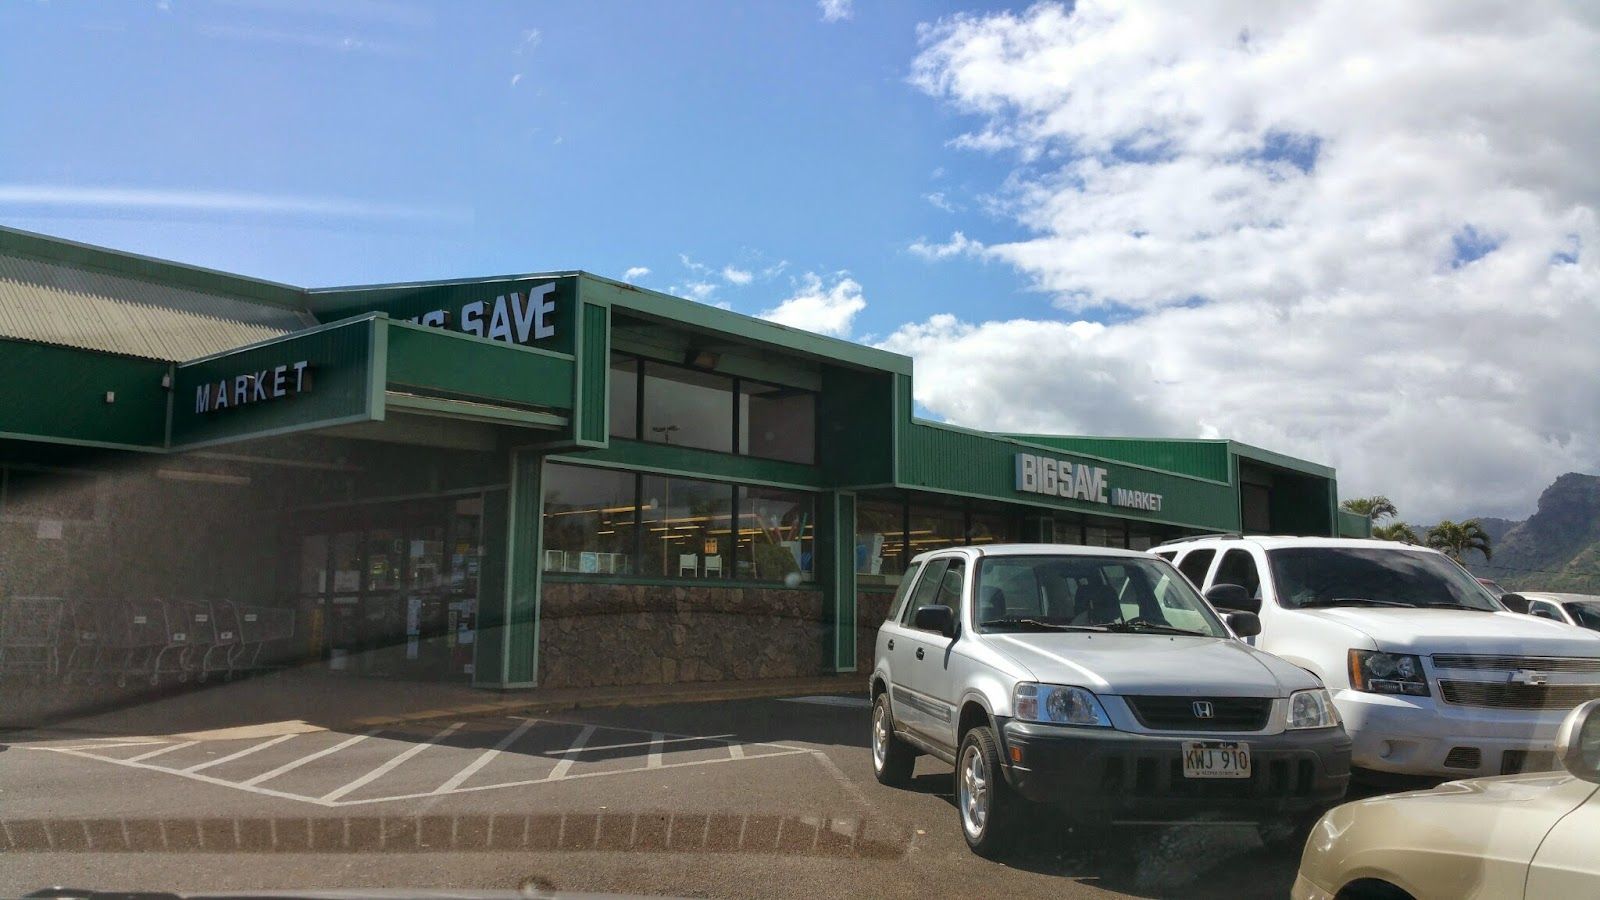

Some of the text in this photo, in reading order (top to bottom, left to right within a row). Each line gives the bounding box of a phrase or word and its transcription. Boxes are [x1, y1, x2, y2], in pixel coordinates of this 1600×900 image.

[461, 281, 556, 344] SAVE
[195, 360, 309, 414] MARKET
[1117, 487, 1163, 512] MARKET
[1186, 750, 1248, 770] KWJ 910
